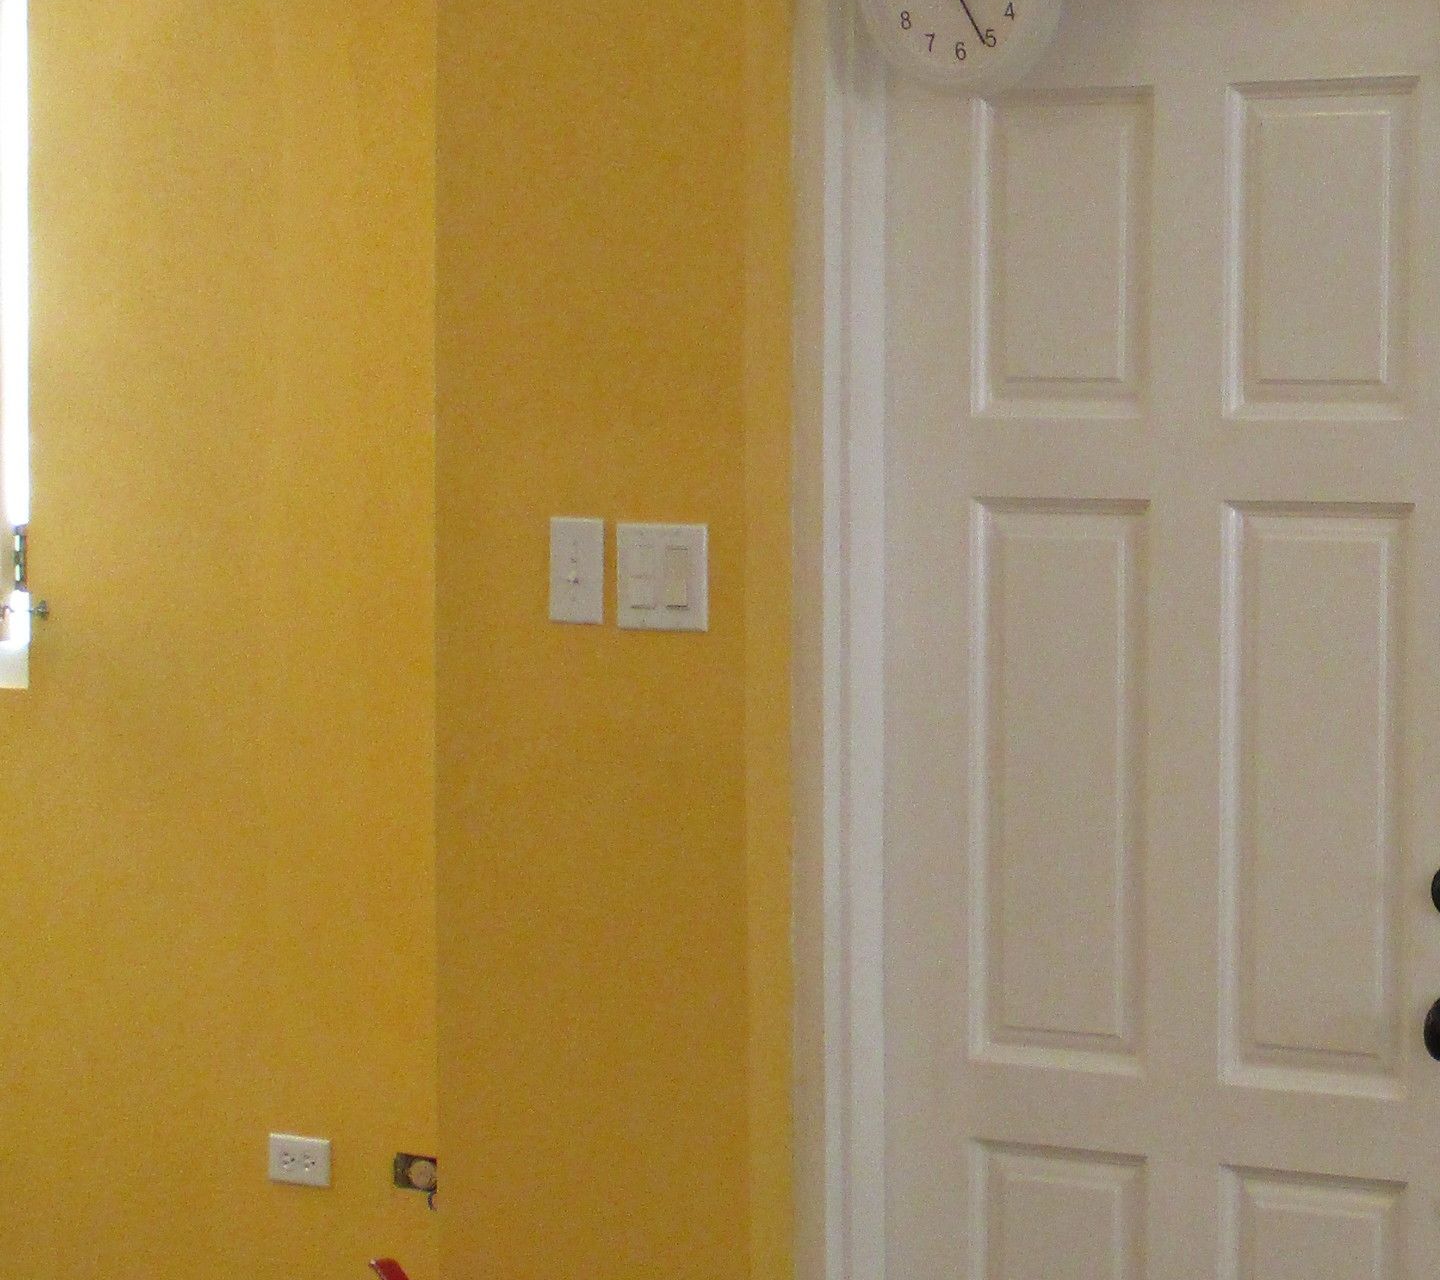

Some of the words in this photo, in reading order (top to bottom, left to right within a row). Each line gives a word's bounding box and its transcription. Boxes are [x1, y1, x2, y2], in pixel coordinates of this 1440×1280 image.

[900, 10, 912, 30] 8
[1004, 1, 1015, 21] 4
[925, 33, 936, 53] 7
[984, 28, 997, 48] 5
[955, 41, 967, 61] 6
